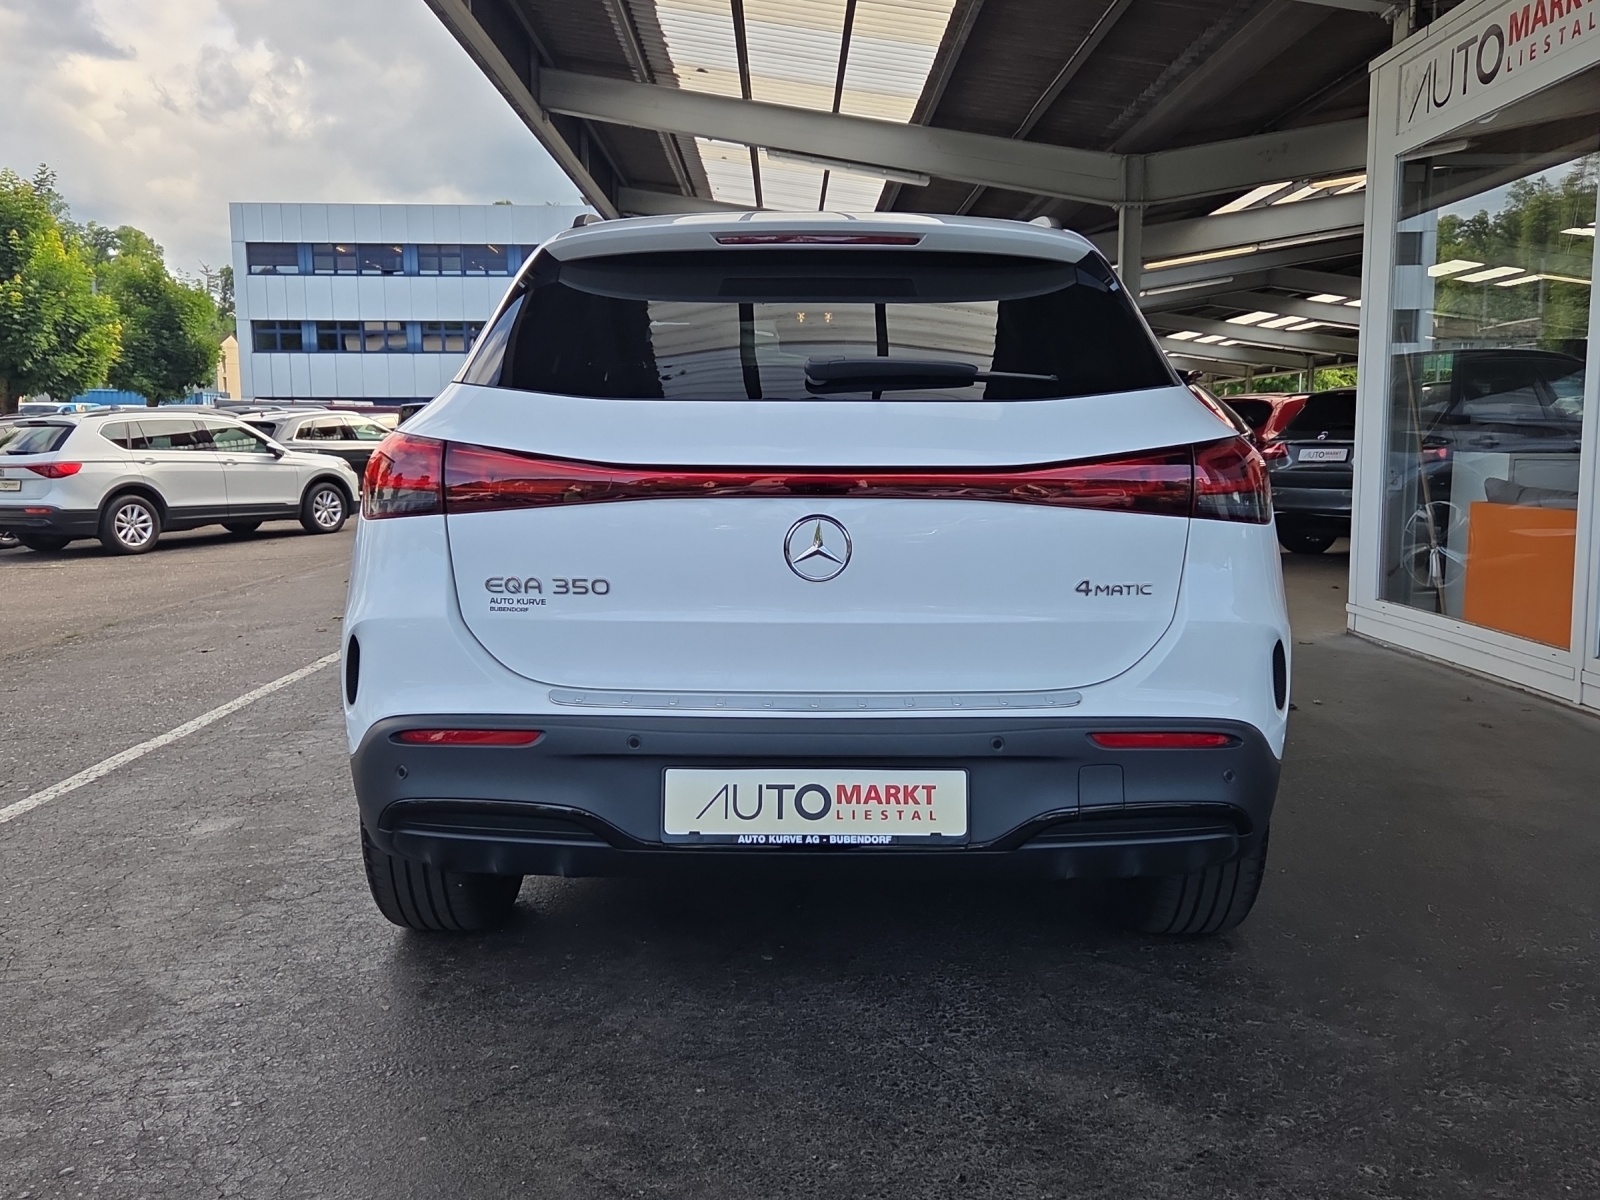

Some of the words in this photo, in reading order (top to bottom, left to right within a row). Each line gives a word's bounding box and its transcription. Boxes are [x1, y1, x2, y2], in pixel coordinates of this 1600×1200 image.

[1506, 12, 1596, 73] LIESTAL
[1408, 24, 1505, 123] AUTO
[1508, 0, 1593, 47] MAR
[485, 576, 543, 595] EQA
[552, 578, 610, 596] 350
[1075, 579, 1153, 597] 4MATIC
[489, 597, 515, 605] AUTO
[516, 598, 547, 606] KURVE
[695, 783, 832, 821] AUTO
[835, 784, 937, 806] MARKT
[835, 809, 937, 821] LIESTAL
[737, 835, 766, 844] AUTO
[768, 835, 803, 844] KURVE
[805, 835, 820, 844] AG
[829, 835, 892, 844] BUBENDORF
